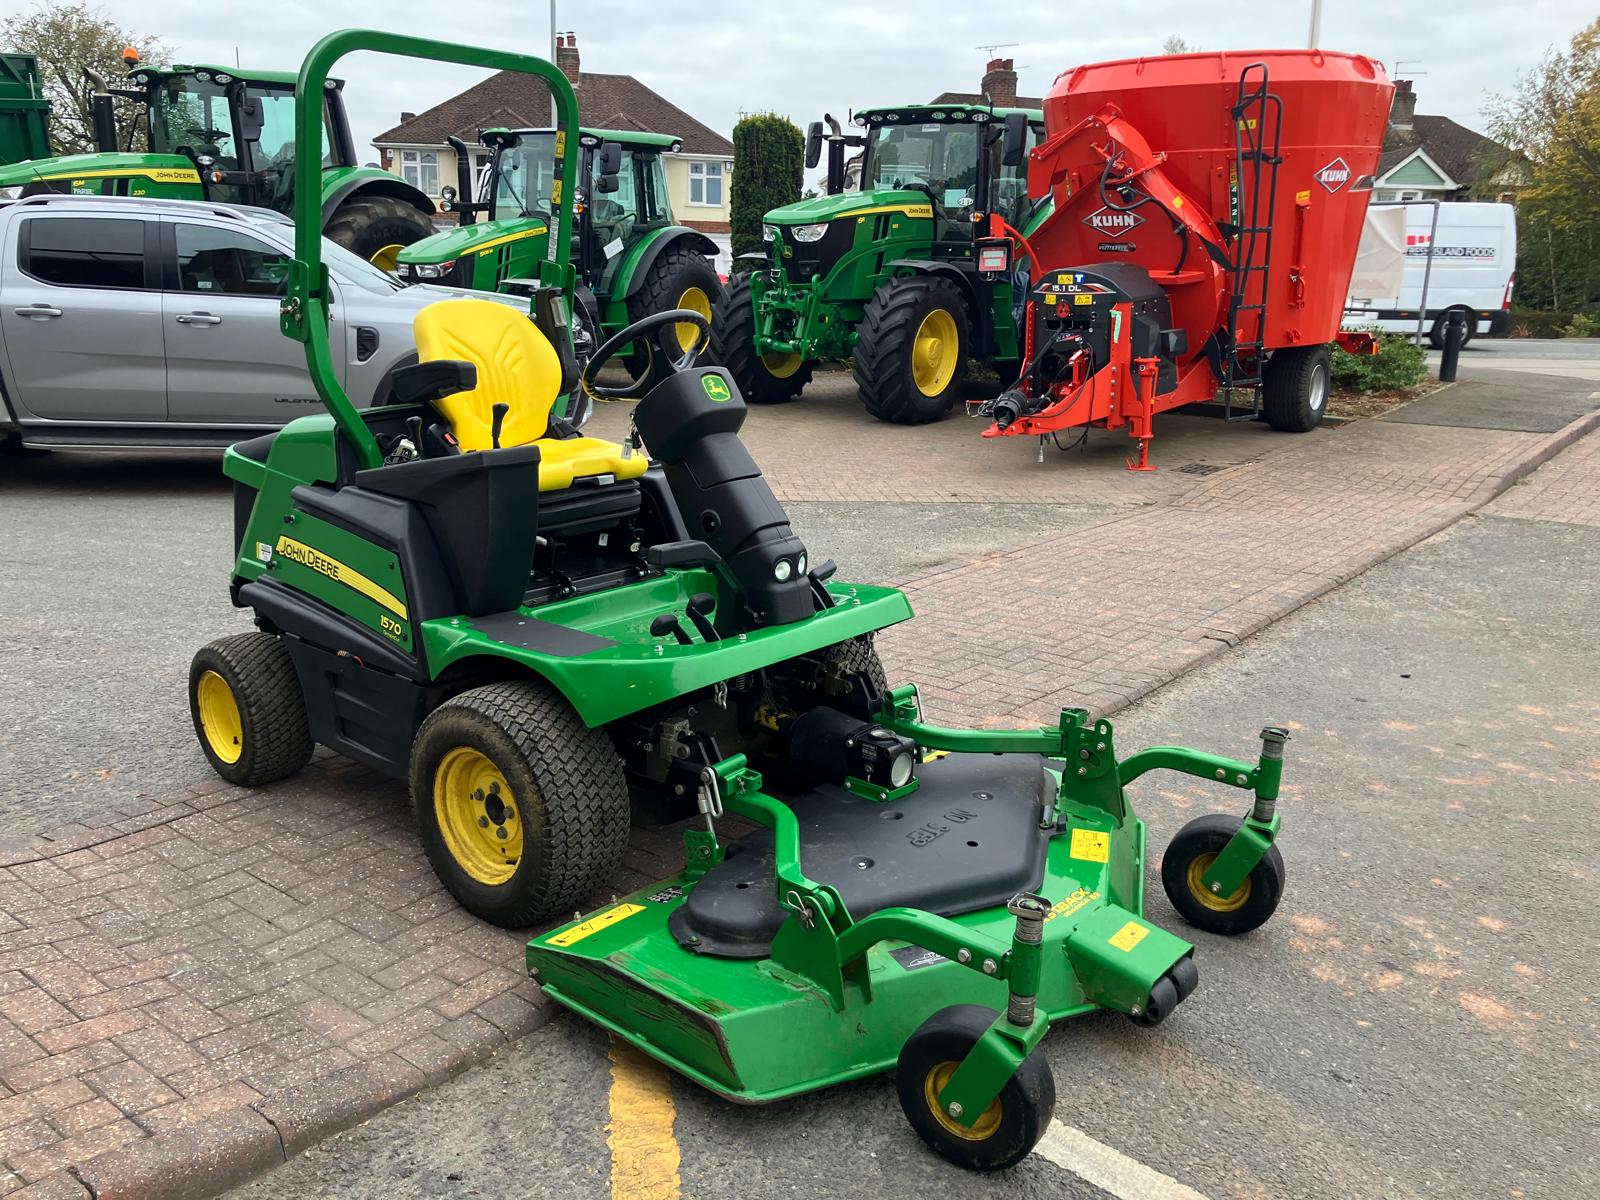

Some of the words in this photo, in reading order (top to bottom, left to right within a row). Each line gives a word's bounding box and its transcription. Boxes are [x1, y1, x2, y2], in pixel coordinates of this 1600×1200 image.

[1321, 170, 1348, 182] KUHN
[1092, 215, 1135, 227] KUHN
[1465, 247, 1496, 257] FOODS
[280, 540, 306, 562] JOHN
[307, 550, 339, 579] DEERE
[380, 615, 402, 635] 1570
[943, 807, 978, 824] NO
[905, 822, 951, 847] STEP
[1044, 887, 1090, 922] ASTBACK
